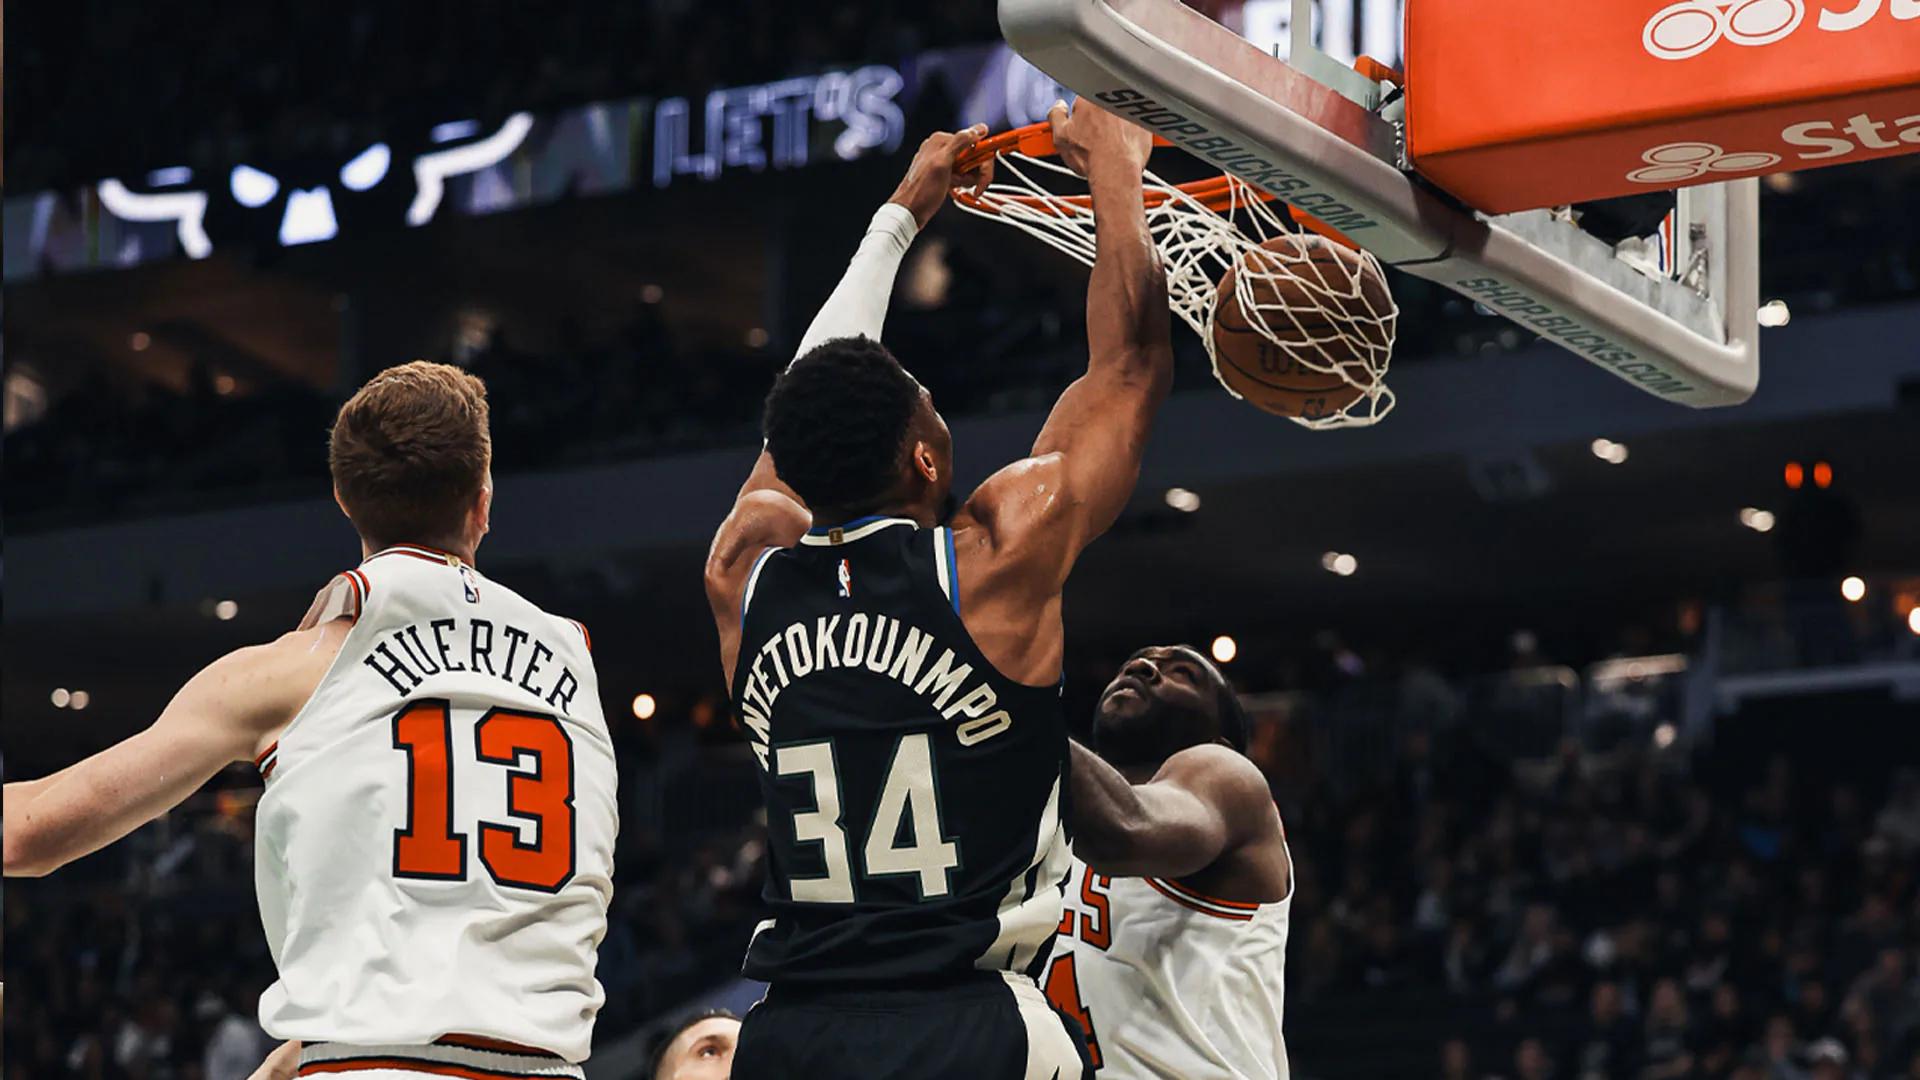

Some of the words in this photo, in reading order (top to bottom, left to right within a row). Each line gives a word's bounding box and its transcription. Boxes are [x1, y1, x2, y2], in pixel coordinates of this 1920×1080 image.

[653, 65, 905, 188] LET'S
[1095, 89, 1379, 232] SHOP.BUCKS.COM
[1457, 277, 1694, 394] SHOP.BUCKS.COM
[364, 618, 578, 716] HUERTER
[742, 612, 1012, 772] ANTETOKOUNMPO
[391, 697, 576, 894] 13
[773, 732, 961, 903] 34
